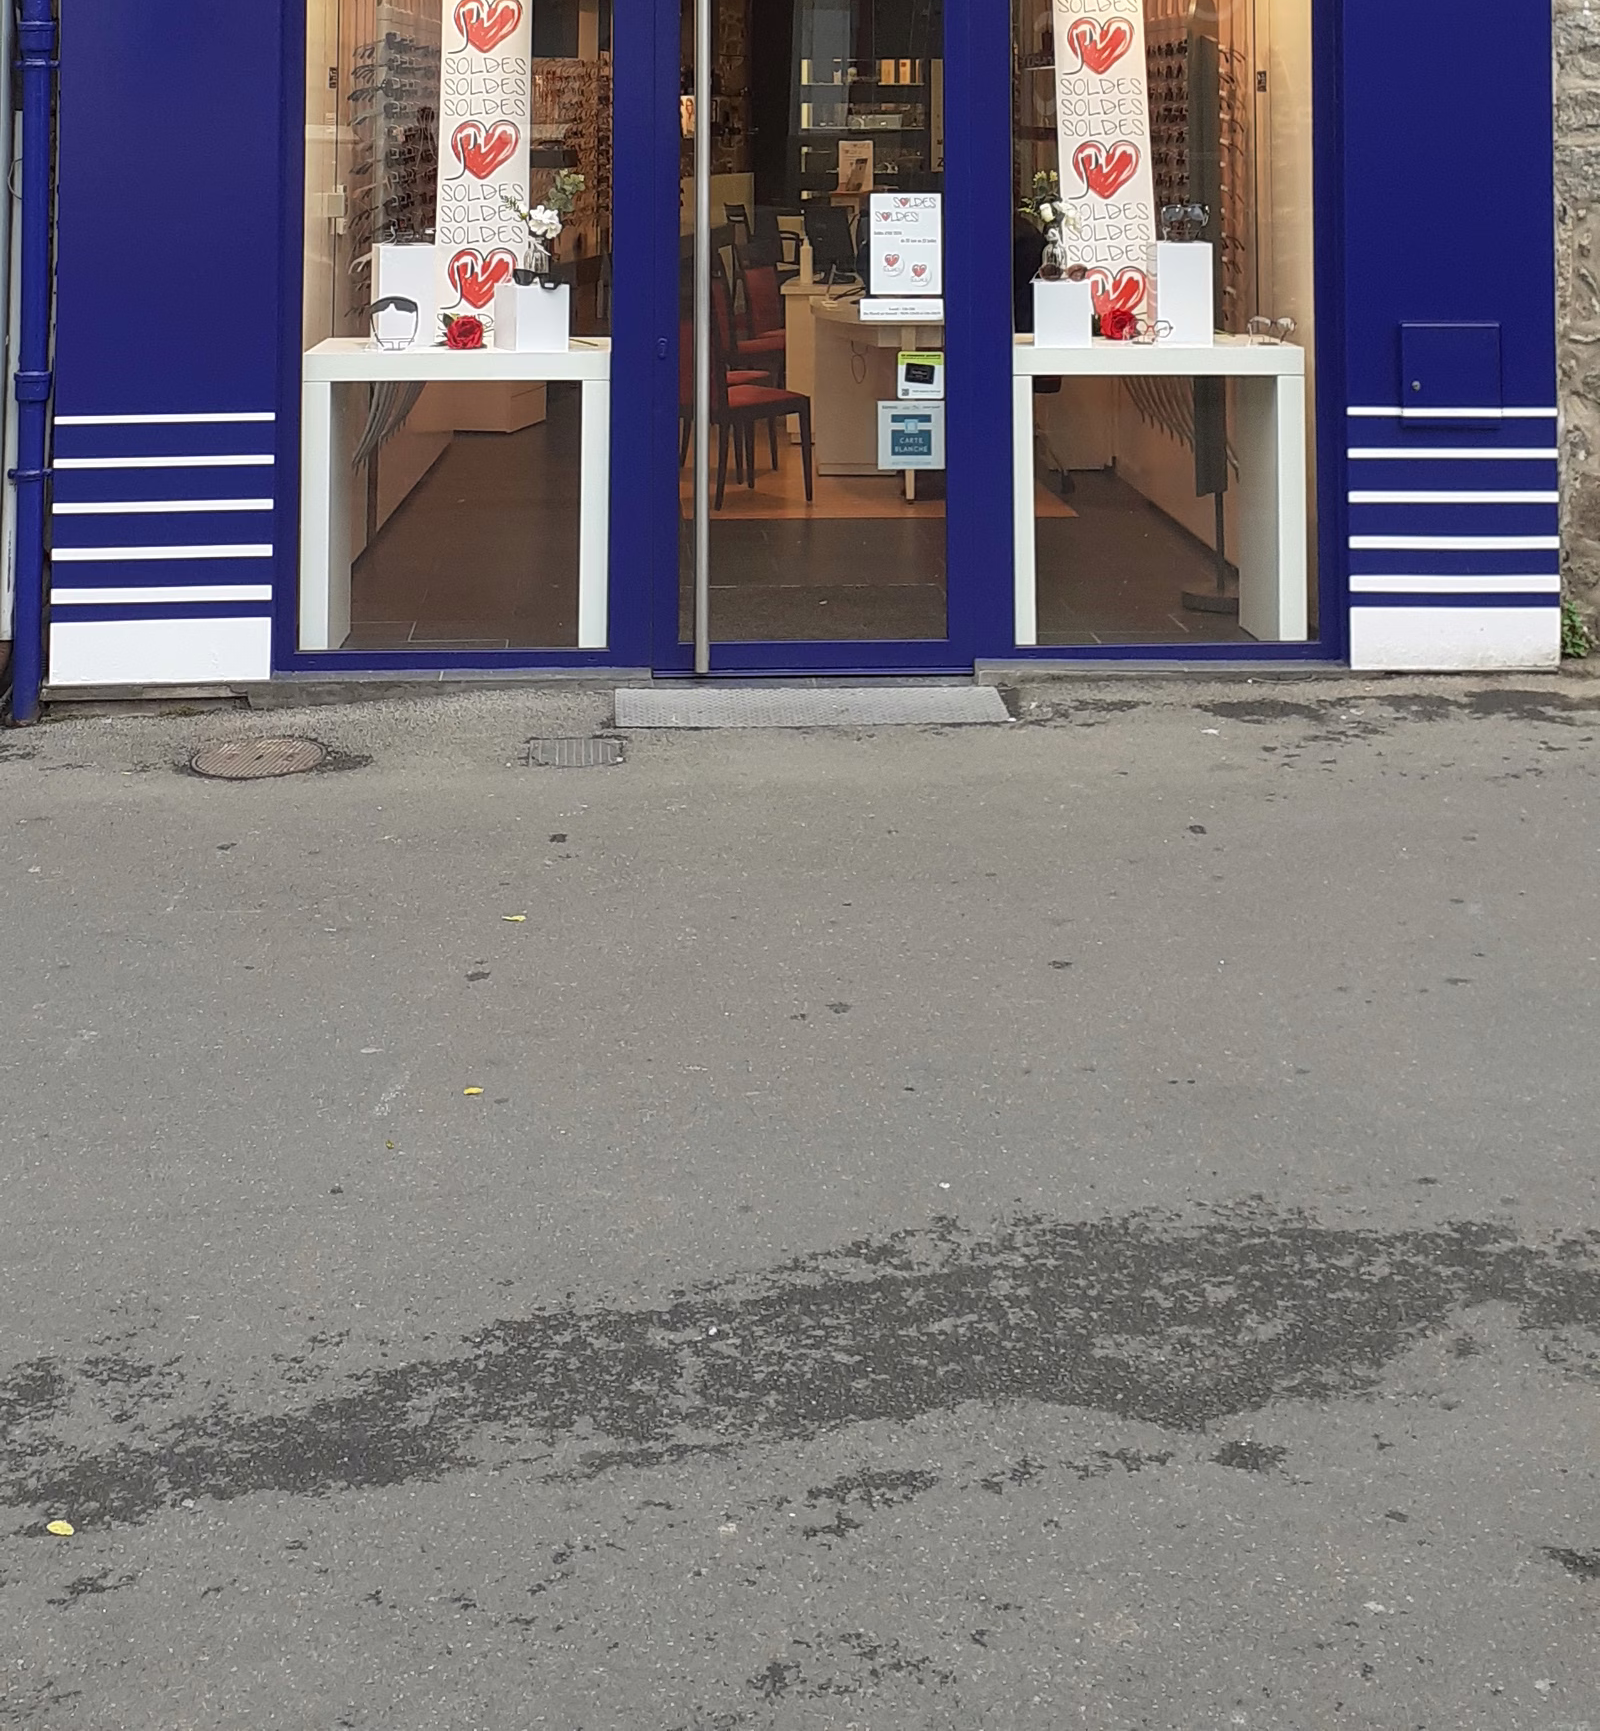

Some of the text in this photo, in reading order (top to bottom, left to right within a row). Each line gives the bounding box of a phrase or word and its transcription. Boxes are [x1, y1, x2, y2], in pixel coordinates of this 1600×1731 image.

[444, 56, 526, 76] SOLDES
[444, 77, 526, 96] SOLDES
[1060, 77, 1142, 96] SOLDES
[444, 98, 526, 117] SOLDES
[1061, 98, 1143, 117] SOLDES
[1062, 118, 1145, 137] SOLDES
[441, 183, 524, 202] SOLDES
[1067, 203, 1149, 222] OLDES
[440, 225, 524, 245] SOLDES
